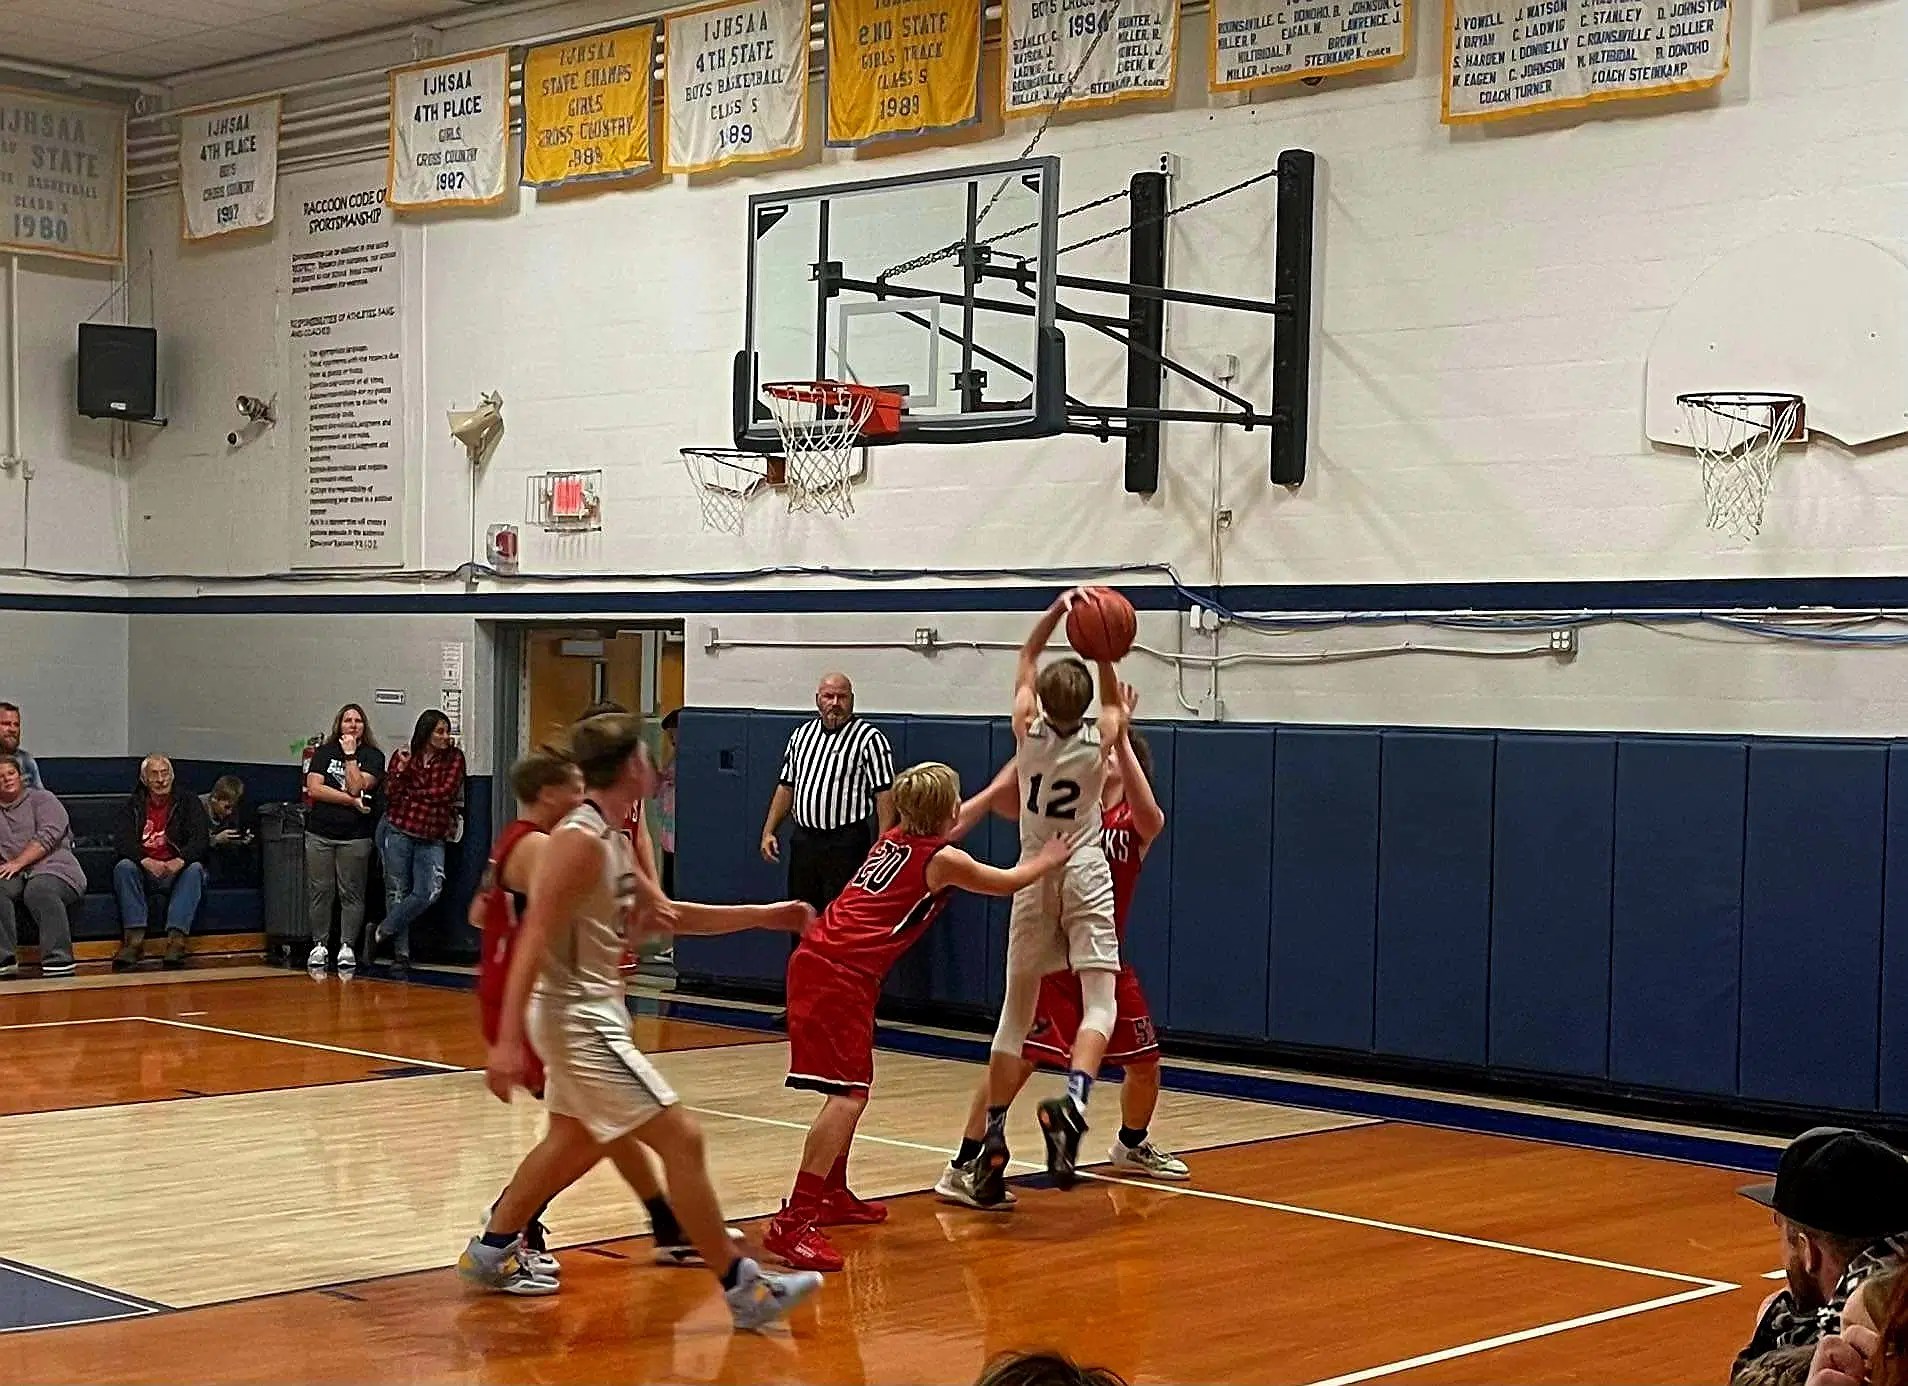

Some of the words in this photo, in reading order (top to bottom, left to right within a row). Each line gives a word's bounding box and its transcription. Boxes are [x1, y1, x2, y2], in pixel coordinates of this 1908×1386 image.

[1463, 12, 1505, 31] VOWELL
[1526, 0, 1568, 19] WATSON
[1593, 7, 1643, 26] STANLEY
[704, 10, 768, 42] IJHSAA
[859, 20, 892, 46] 2ND
[902, 11, 949, 38] STATE
[1069, 9, 1109, 38] 1994
[1525, 18, 1566, 39] LADWIG
[1669, 18, 1714, 39] COLLIER
[559, 39, 617, 66] IJHSAA
[696, 48, 726, 73] 4TH
[731, 40, 775, 66] STATE
[861, 48, 896, 70] GIRLS
[903, 41, 943, 63] TRACK
[1464, 50, 1506, 68] HARDEN
[1519, 37, 1569, 60] DONNELLY
[1667, 39, 1710, 59] DONOHO
[542, 72, 579, 97] STATE
[584, 63, 632, 88] CHAMPS
[878, 70, 913, 90] CLASS
[919, 68, 928, 84] S
[1463, 70, 1497, 87] EAGEN
[1520, 56, 1566, 79] JOHNSON
[1591, 68, 1627, 85] COACH
[423, 70, 472, 96] IJHSAA
[685, 82, 713, 102] BOYS
[1479, 88, 1512, 105] COACH
[1514, 79, 1553, 100] TURNER
[414, 103, 439, 122] 4TH
[443, 95, 482, 119] PLACE
[568, 94, 604, 117] GIRLS
[751, 97, 758, 113] S
[880, 94, 920, 120] 1989
[208, 114, 249, 137] IJHSAA
[580, 114, 633, 140] COUNTRY
[719, 124, 753, 149] 189
[200, 143, 220, 161] 4TH
[225, 135, 257, 157] PLACE
[416, 152, 442, 167] CROSS
[31, 144, 99, 178] STATE
[436, 171, 465, 191] 1987
[303, 195, 348, 216] RACCOON
[348, 190, 375, 209] CODE
[14, 213, 69, 243] 1980
[309, 207, 382, 235] SPORTSMANSHIP
[1027, 773, 1081, 821] 12
[851, 839, 913, 896] 20
